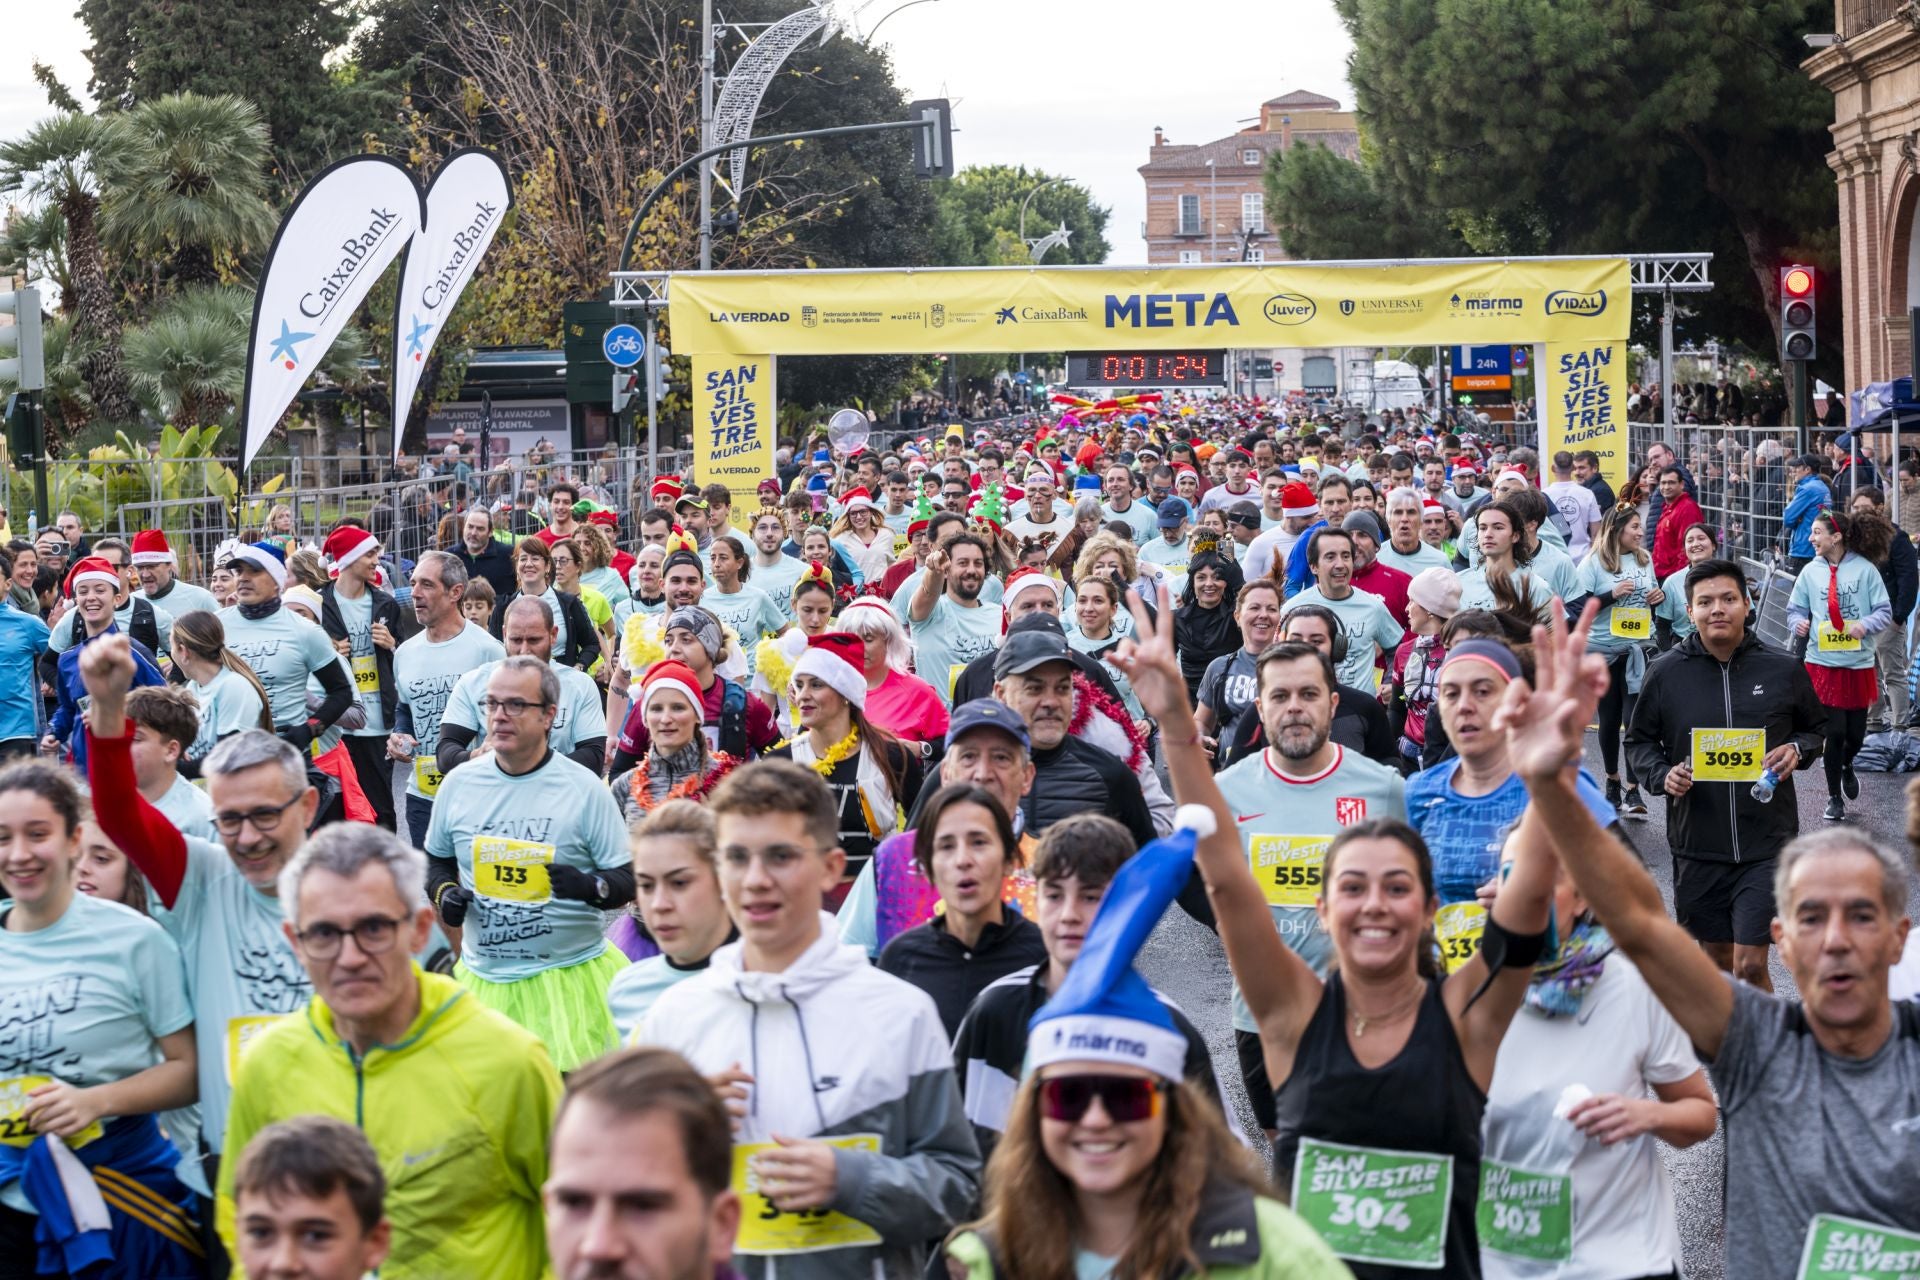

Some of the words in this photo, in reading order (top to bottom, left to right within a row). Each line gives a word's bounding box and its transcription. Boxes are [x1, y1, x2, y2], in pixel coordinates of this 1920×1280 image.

[300, 208, 397, 318] CaixaBank
[422, 200, 497, 310] CaixaBank
[1022, 306, 1088, 320] CaixaBank
[1104, 293, 1240, 328] META
[1270, 303, 1311, 315] Juver
[1361, 300, 1424, 308] UNIVERSAE
[1465, 298, 1523, 310] marmo
[1554, 297, 1599, 310] VIDAL
[710, 312, 728, 323] LA
[730, 312, 790, 323] VERDAD
[1104, 356, 1207, 380] 0:01:24
[1477, 359, 1498, 369] 24h
[1558, 346, 1613, 374] SAN
[705, 364, 758, 391] SAN
[1467, 379, 1496, 388] telpark
[1567, 367, 1605, 393] SIL
[713, 385, 750, 409] SIL
[1562, 384, 1611, 412] VES
[430, 409, 503, 420] IMPLANTOLÍA
[504, 410, 551, 419] AVANZADA
[499, 420, 533, 429] DENTAL
[707, 402, 757, 428] VES
[1563, 405, 1613, 432] TRE
[709, 421, 758, 448] TRE
[1563, 423, 1617, 445] MURCIA
[710, 440, 762, 461] MURCIA
[709, 467, 722, 475] LA
[723, 466, 761, 475] VERDAD
[1621, 620, 1641, 630] 688
[354, 671, 376, 684] 599
[1700, 733, 1761, 753] SILVESTRE
[1701, 733, 1725, 745] SAN
[1705, 751, 1754, 766] 3093
[479, 847, 547, 864] SILVESTRE
[480, 842, 508, 854] SAN
[1258, 840, 1291, 855] SAN
[1258, 842, 1330, 867] SILVESTR
[493, 864, 528, 885] 133
[1274, 866, 1322, 886] 555
[478, 921, 553, 947] MURCIA
[1068, 1033, 1146, 1058] marmo
[1313, 1153, 1369, 1174] SAN
[1310, 1163, 1441, 1194] SILVESTRE
[1484, 1166, 1512, 1187] SAN
[1383, 1182, 1436, 1199] MURCIA
[1483, 1178, 1563, 1202] SILVESTRE
[1328, 1192, 1412, 1234] 304
[1493, 1202, 1542, 1237] 303
[1825, 1231, 1886, 1254] SAN
